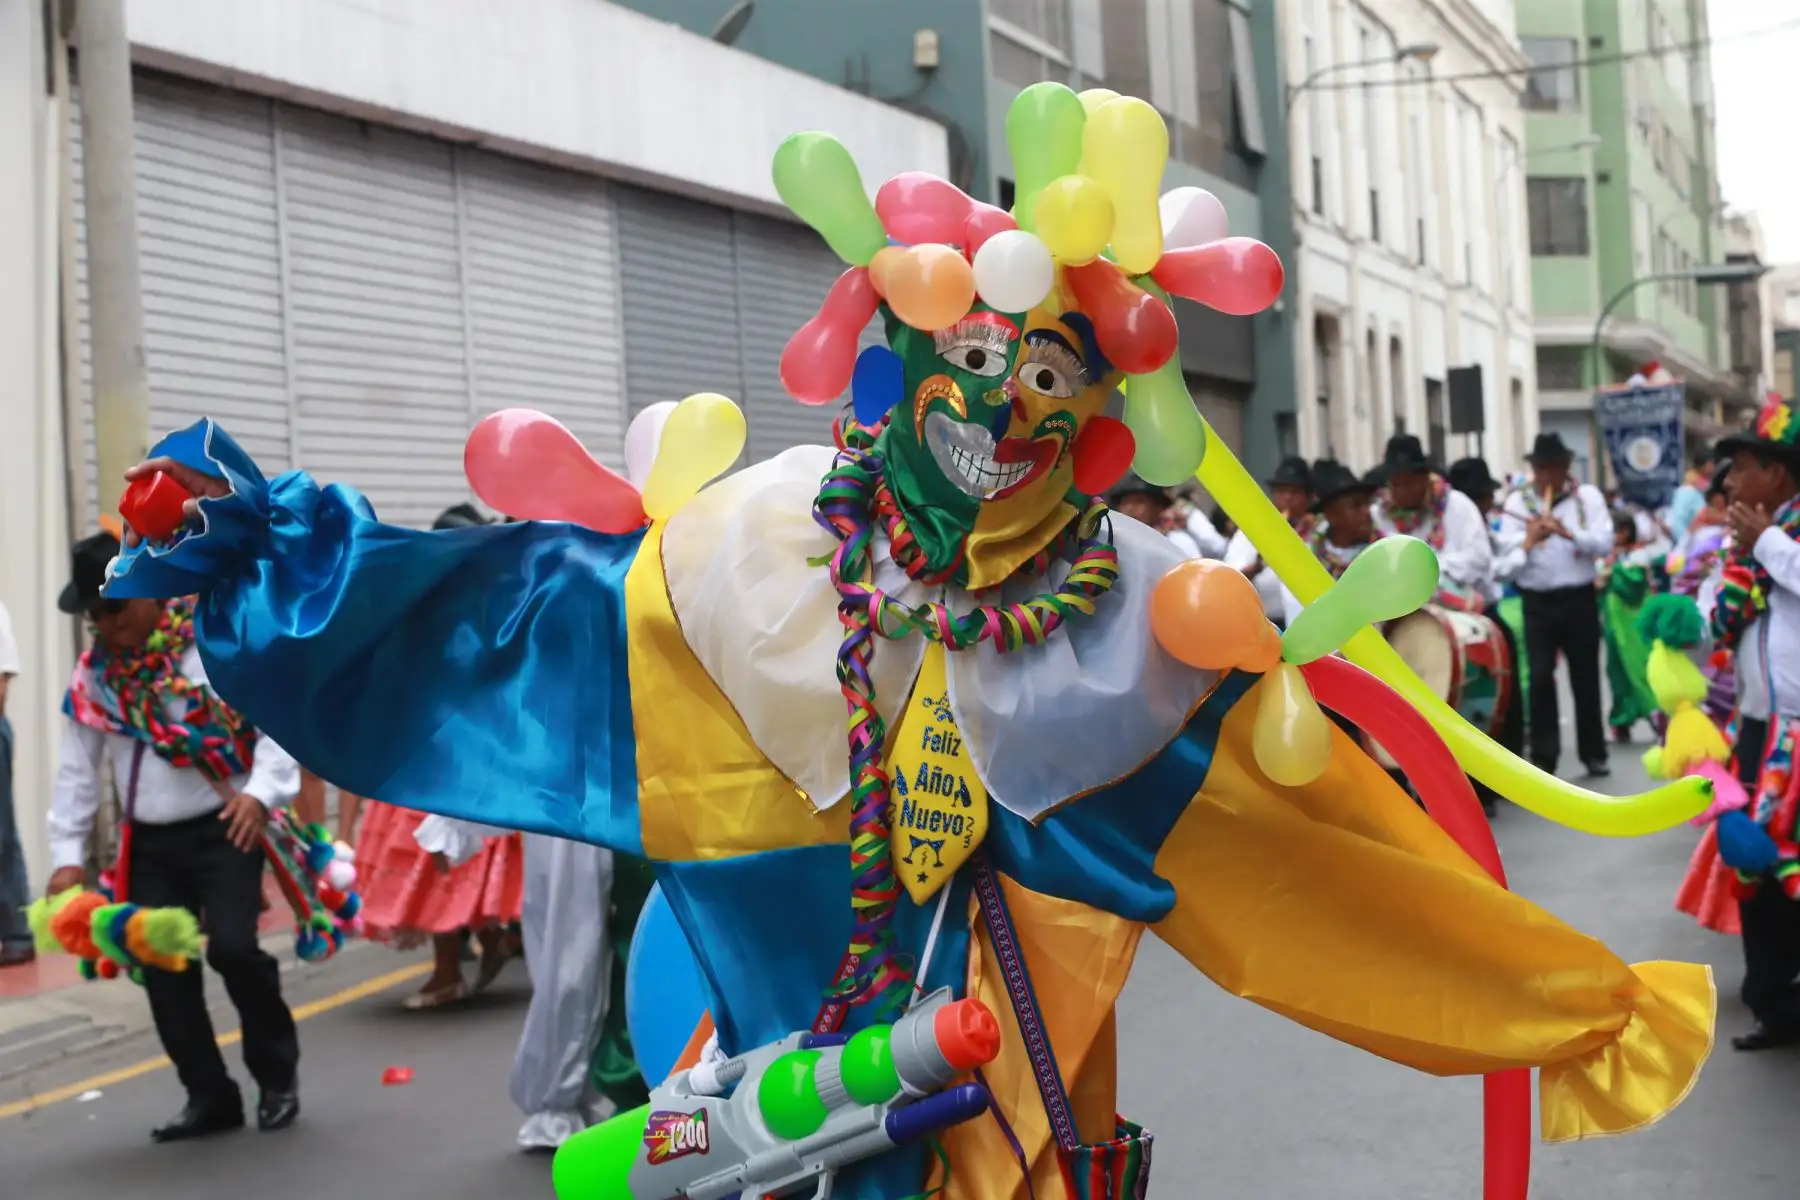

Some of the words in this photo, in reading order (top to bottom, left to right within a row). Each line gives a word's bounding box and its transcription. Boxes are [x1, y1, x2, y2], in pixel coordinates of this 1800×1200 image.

[914, 762, 954, 797] Año
[899, 798, 964, 836] Nuevo
[669, 1118, 707, 1153] 1200
